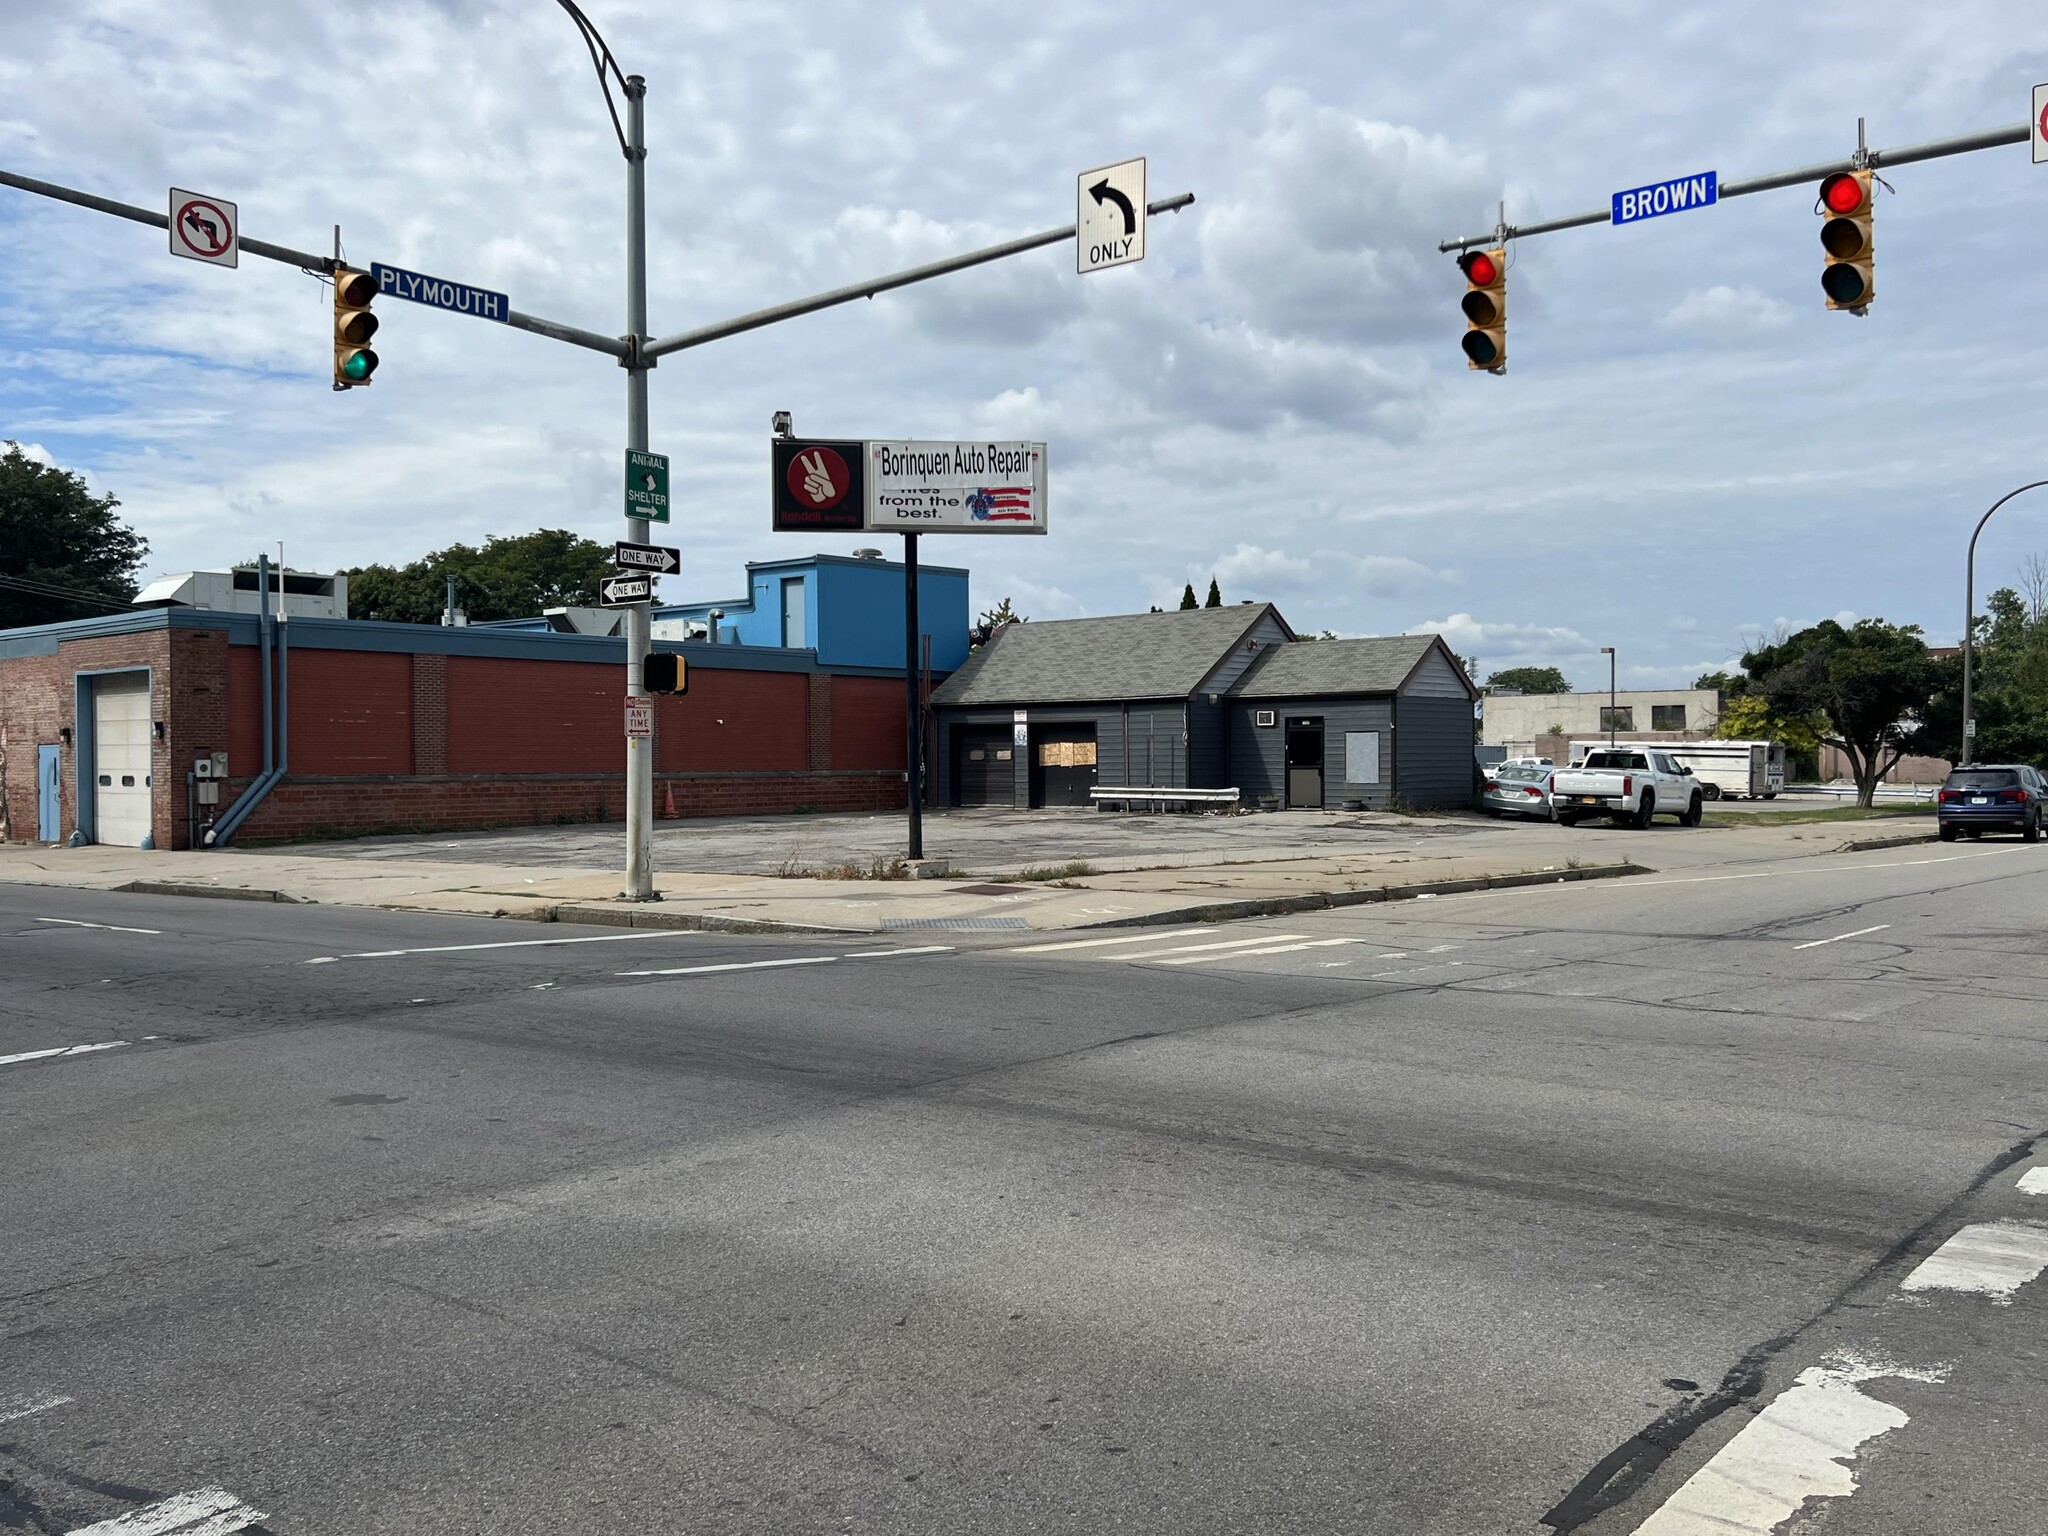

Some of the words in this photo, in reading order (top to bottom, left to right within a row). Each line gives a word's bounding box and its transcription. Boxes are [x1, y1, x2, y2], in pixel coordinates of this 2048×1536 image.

[1622, 176, 1706, 220] BROWN
[1090, 237, 1133, 264] ONLY
[380, 268, 498, 318] PLYMOUTH
[632, 453, 664, 470] ANIMAL
[881, 446, 950, 483] Borinquen
[954, 445, 984, 475] Auto
[988, 444, 1031, 481] Repair
[628, 490, 666, 506] SHELTER
[879, 496, 927, 506] from
[929, 496, 959, 507] the
[896, 508, 942, 518] best.
[622, 550, 641, 563] ONE
[645, 553, 665, 565] WAY
[613, 584, 628, 596] ONE
[631, 582, 647, 594] WAY
[631, 710, 647, 718] ANY
[629, 719, 649, 727] TIME
